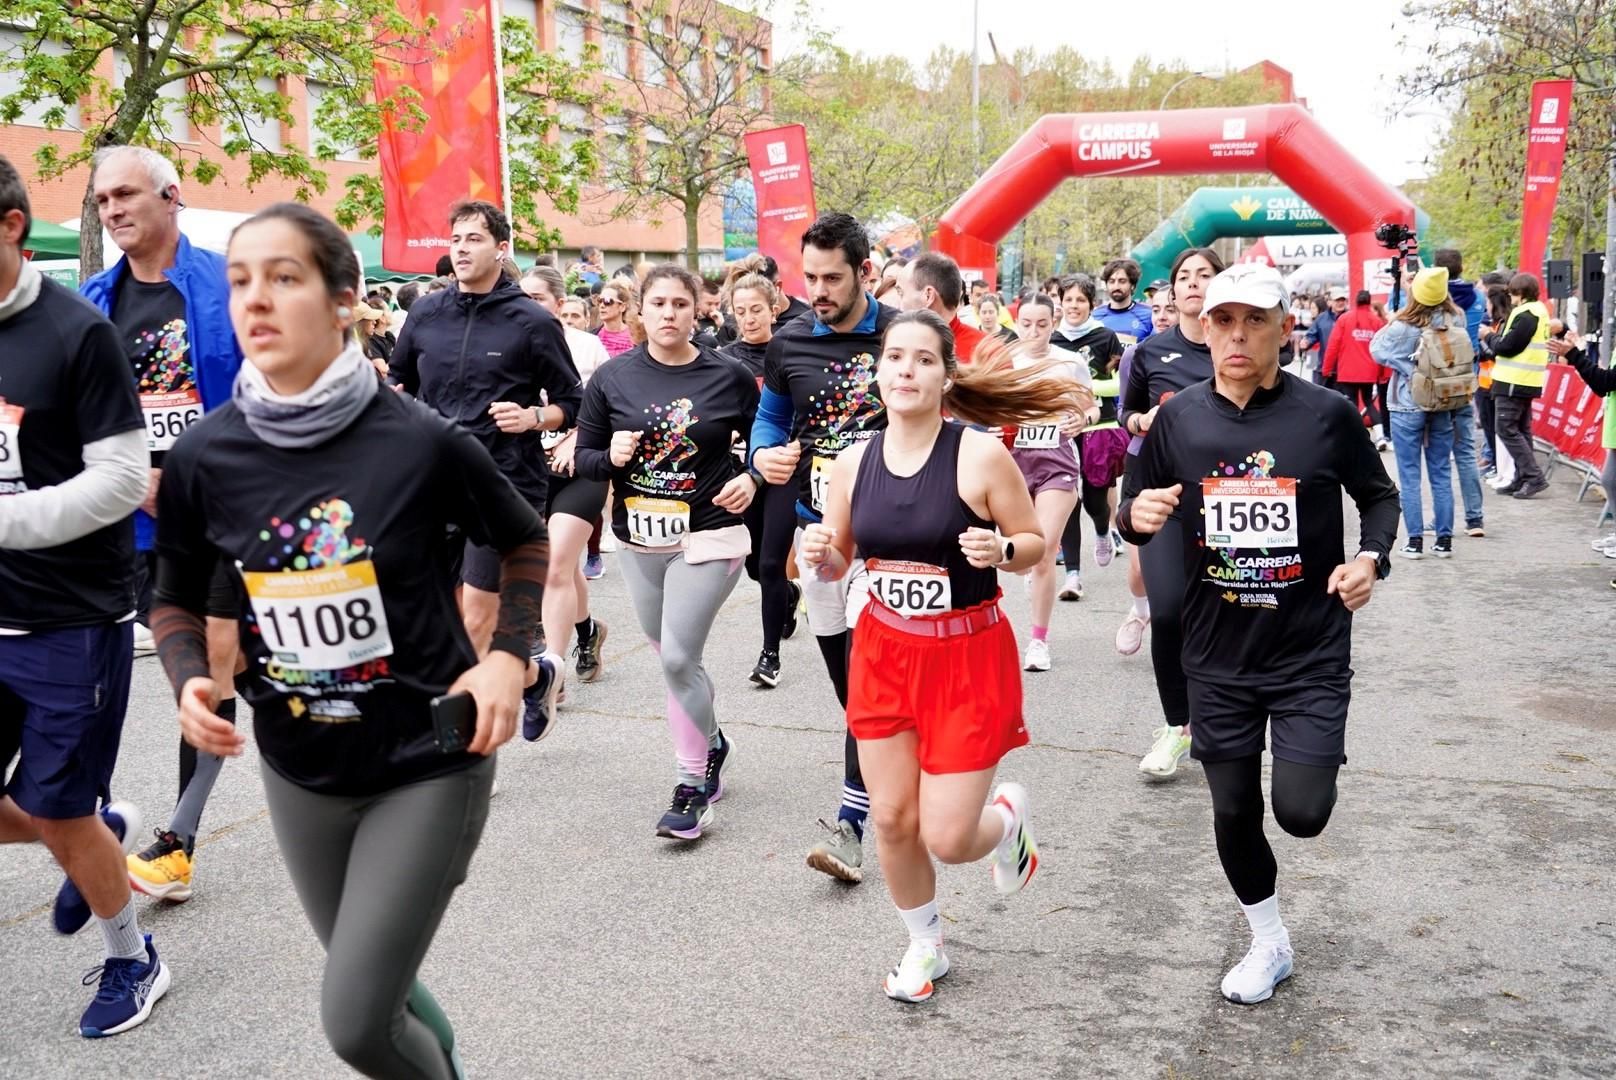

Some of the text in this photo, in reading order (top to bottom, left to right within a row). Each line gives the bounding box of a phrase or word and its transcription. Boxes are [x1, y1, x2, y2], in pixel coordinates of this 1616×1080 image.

[1078, 121, 1161, 142] CARRERA
[1078, 141, 1152, 161] CAMPUS
[1209, 142, 1259, 151] UNIVERSIDAD
[1235, 149, 1255, 158] RIOJA
[1267, 198, 1299, 209] CAJA
[1266, 209, 1286, 220] DE
[1282, 243, 1347, 258] LA RIO
[1020, 425, 1057, 440] 1077
[630, 473, 678, 490] CAMPUS
[1219, 480, 1277, 488] CARRERA CAMPUS
[1211, 487, 1286, 495] UNIVERSIDAD DE LA RIOJA
[1211, 501, 1291, 532] 1563
[632, 513, 685, 538] 1110
[1235, 554, 1302, 568] CARRERA
[1207, 564, 1302, 581] CAMPUS UR
[1213, 579, 1249, 588] Universidad
[1271, 581, 1288, 589] Rioja
[873, 577, 945, 610] 1562
[263, 598, 378, 648] 1108
